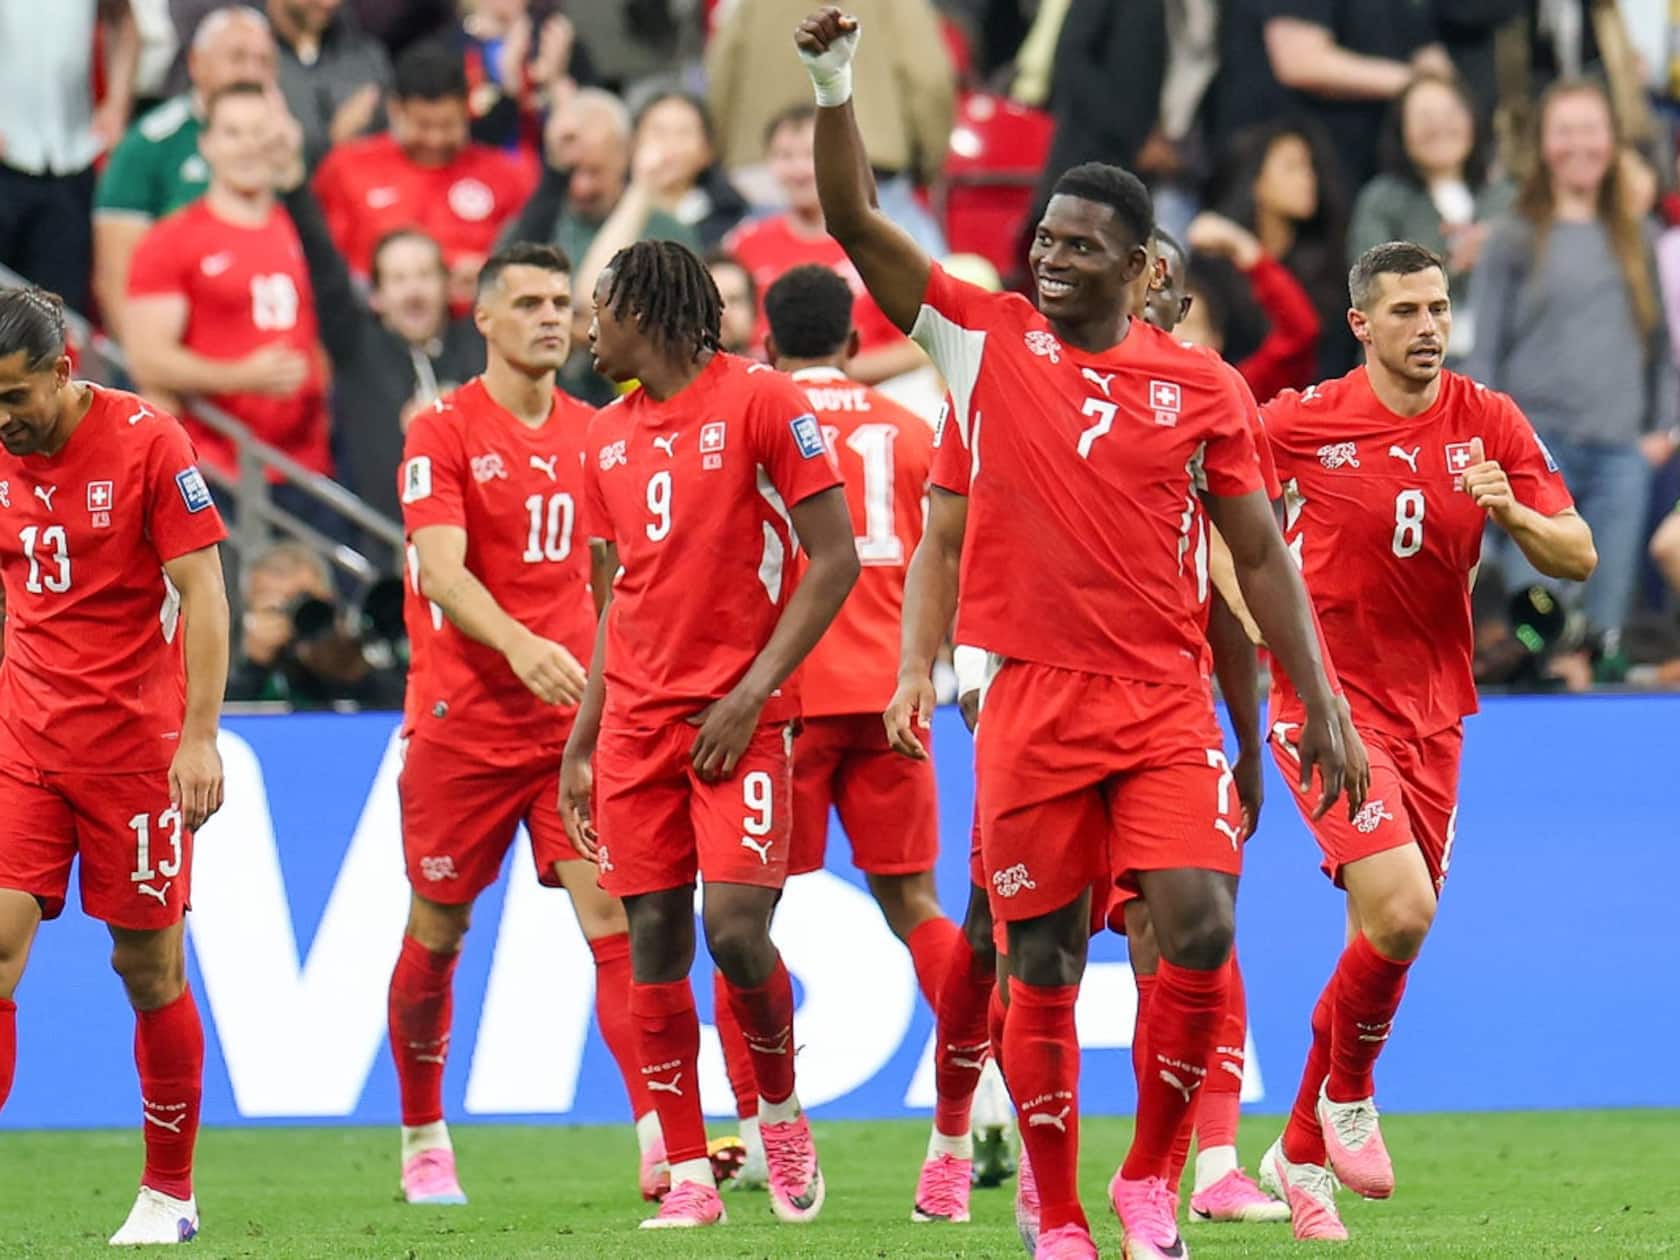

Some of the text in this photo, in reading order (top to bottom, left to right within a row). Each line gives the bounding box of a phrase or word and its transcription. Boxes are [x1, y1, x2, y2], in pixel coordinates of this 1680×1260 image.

[1076, 397, 1119, 460] 7
[522, 492, 575, 563] 10
[646, 470, 672, 542] 9
[1392, 488, 1425, 558] 8
[19, 525, 72, 594] 13
[743, 771, 772, 836] 9
[1206, 748, 1234, 816] 7
[128, 807, 182, 882] 13
